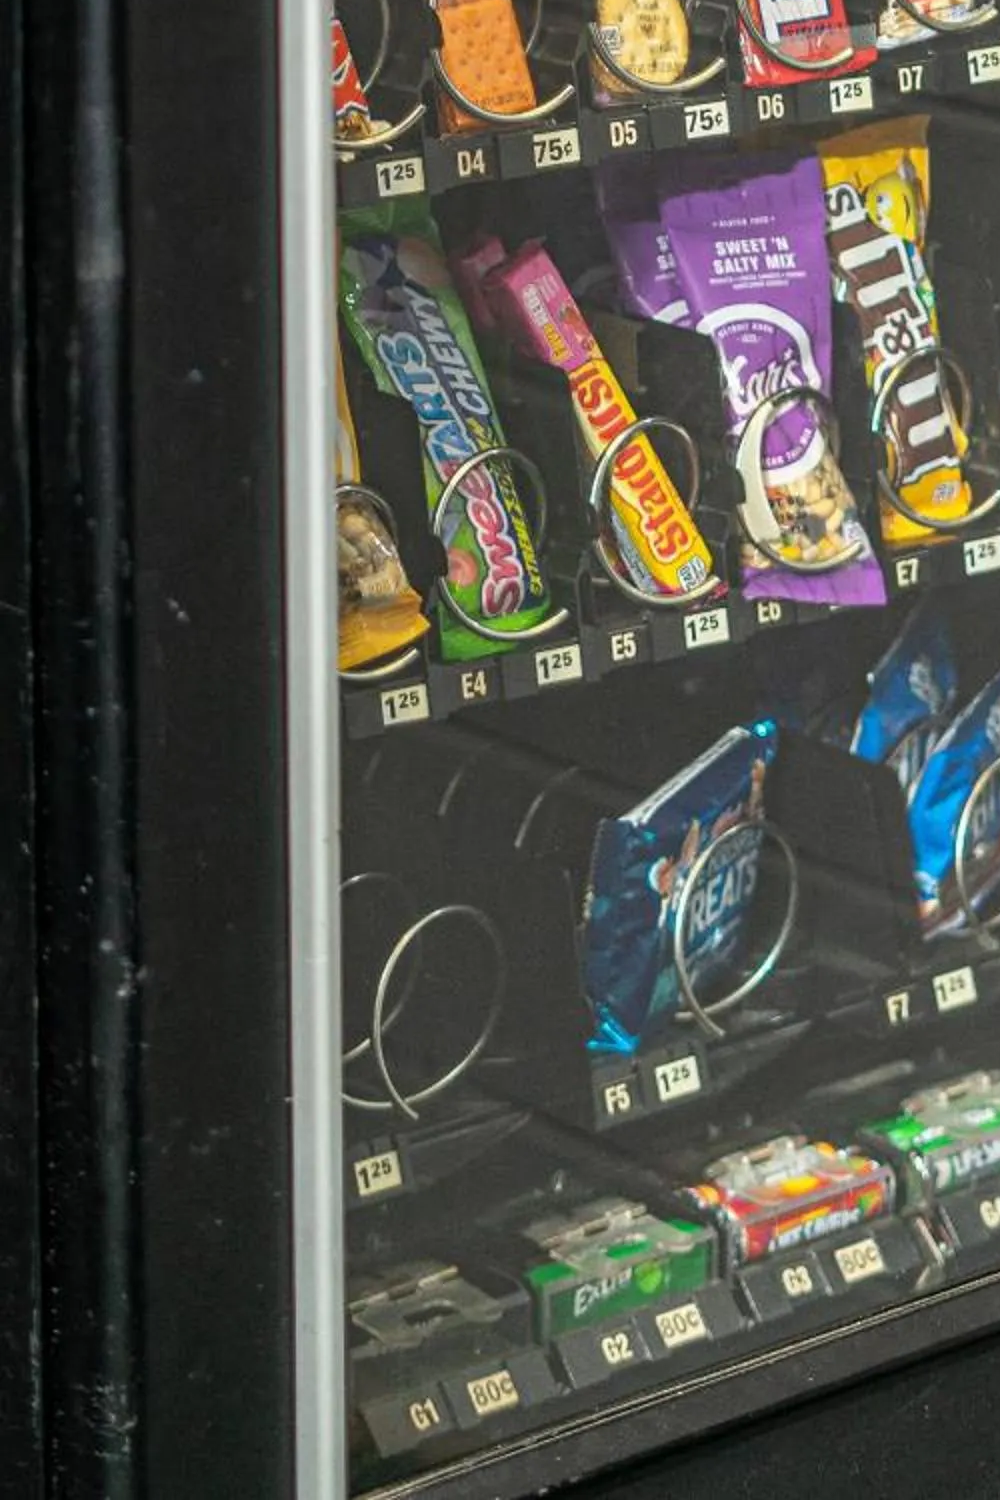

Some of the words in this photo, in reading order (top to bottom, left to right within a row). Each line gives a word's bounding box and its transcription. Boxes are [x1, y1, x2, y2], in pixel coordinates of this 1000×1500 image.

[898, 66, 924, 93] D7
[757, 94, 785, 121] D6
[609, 120, 638, 148] D5
[685, 108, 724, 133] 75¢
[457, 150, 486, 178] D4
[715, 237, 767, 257] SWEET
[713, 255, 759, 275] SALTY
[765, 252, 797, 270] MIX
[402, 285, 490, 416] CHEWY
[611, 632, 637, 662] E5
[461, 672, 487, 700] E4
[605, 1082, 632, 1116] F5
